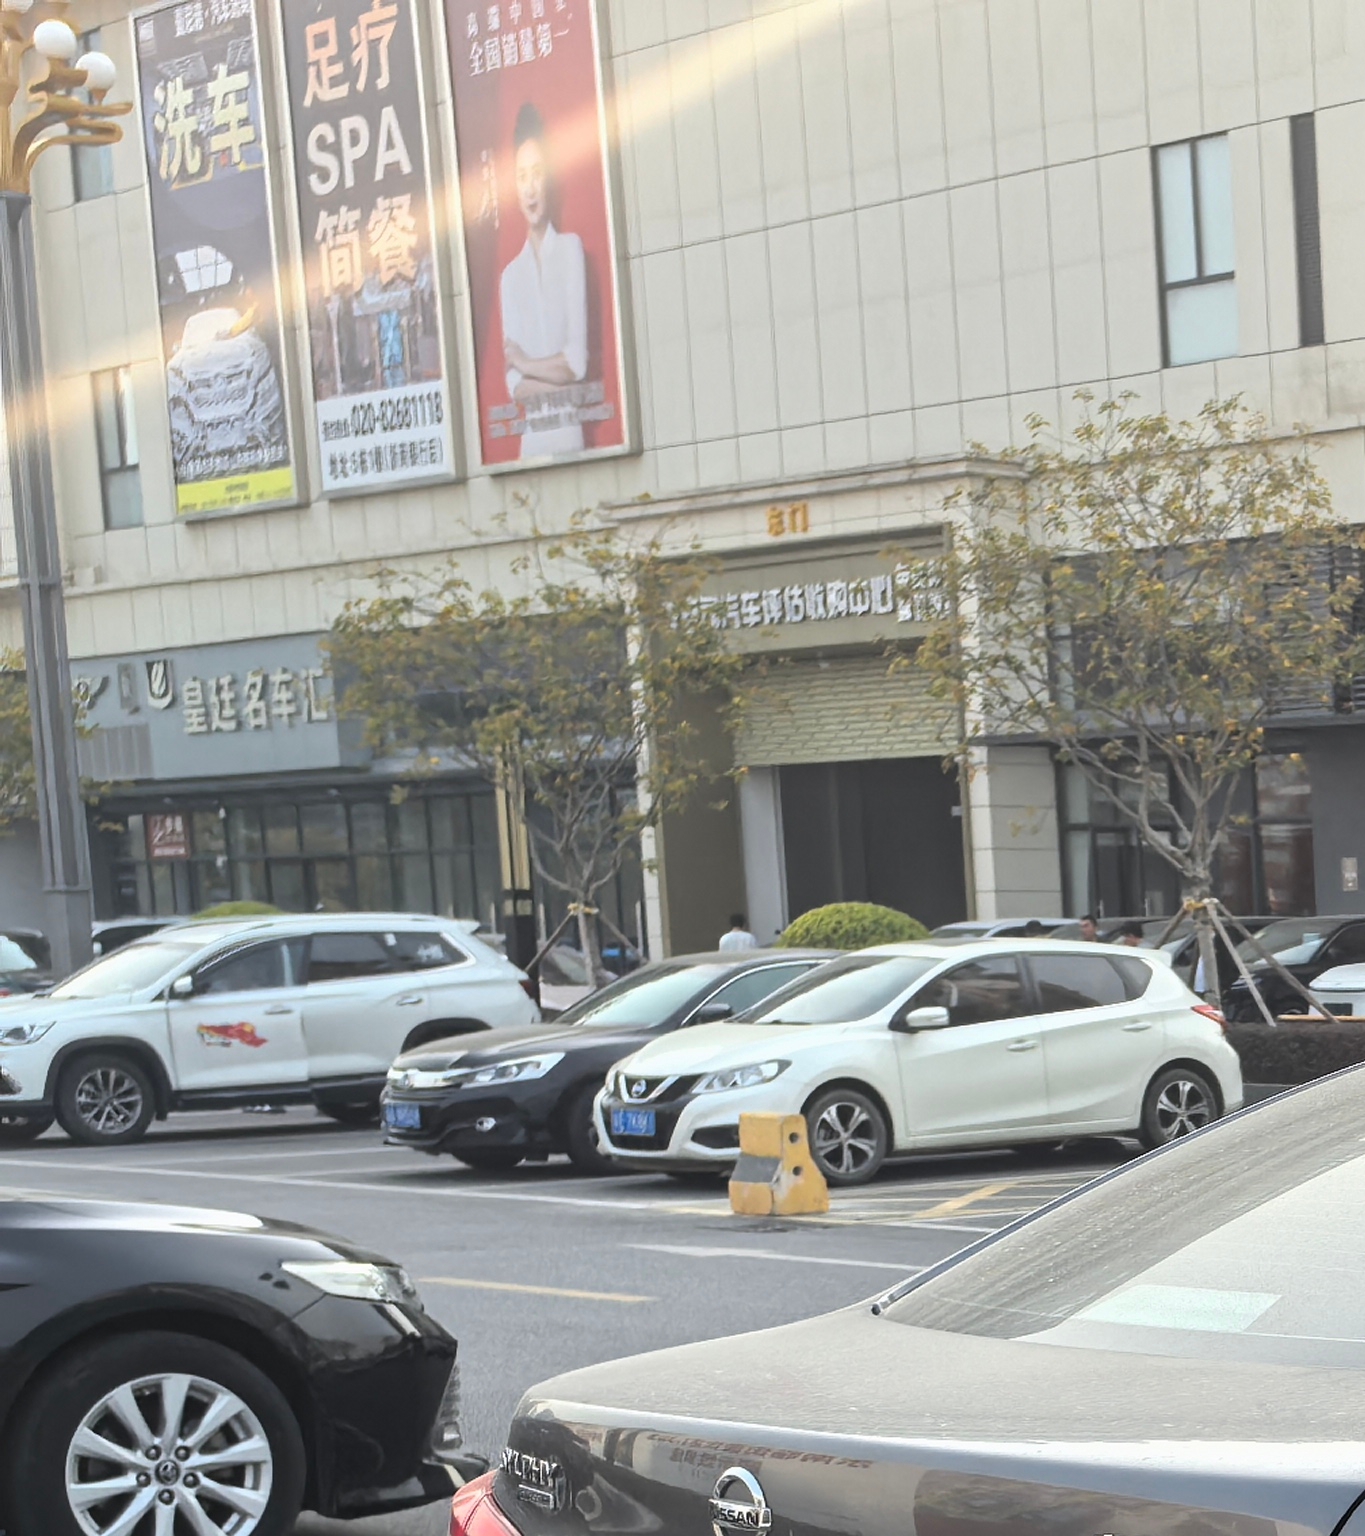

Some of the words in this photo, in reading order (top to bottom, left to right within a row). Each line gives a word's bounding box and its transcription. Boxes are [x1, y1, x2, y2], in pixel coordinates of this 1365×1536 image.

[303, 0, 399, 108] 足疗
[153, 62, 258, 183] 洗车
[307, 105, 413, 196] SPA
[315, 193, 418, 300] 简餐
[183, 667, 329, 735] 皇廷名车汇
